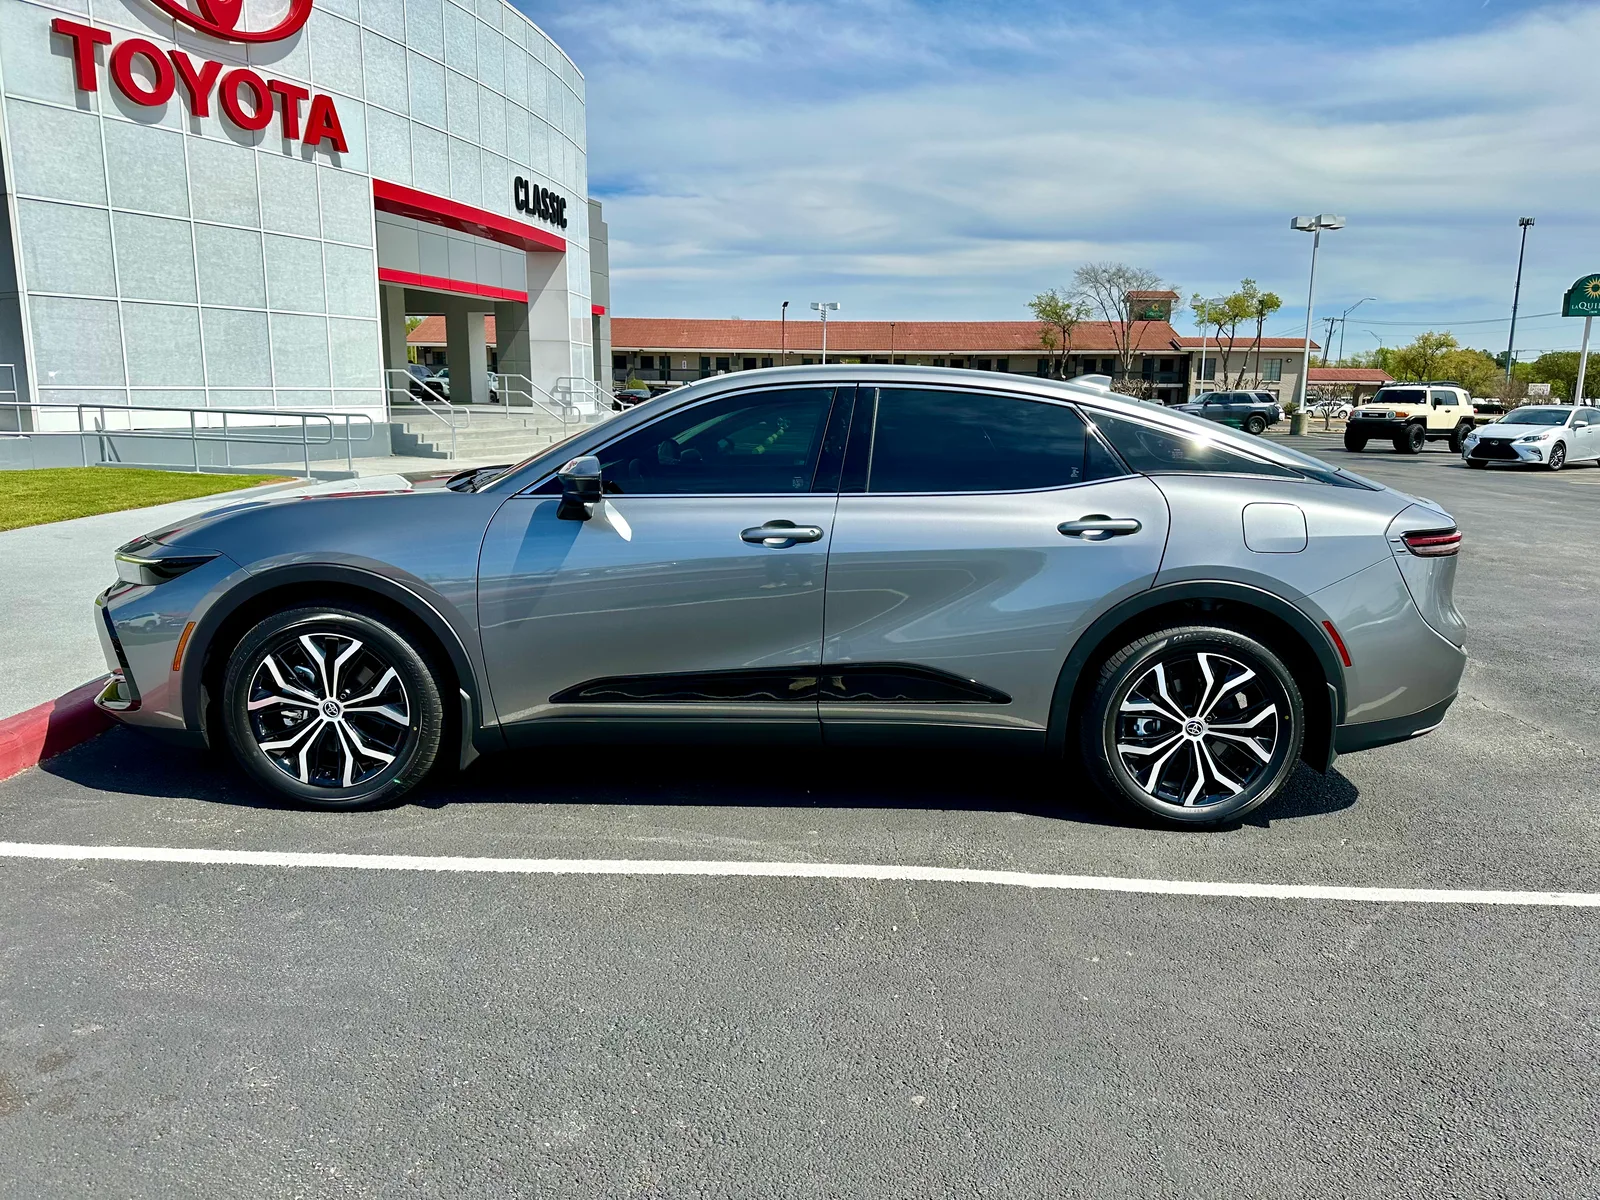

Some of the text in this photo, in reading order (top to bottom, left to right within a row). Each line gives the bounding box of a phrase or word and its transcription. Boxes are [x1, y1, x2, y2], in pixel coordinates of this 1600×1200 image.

[51, 18, 349, 153] TOYOTA
[514, 176, 567, 228] CLASSIC
[1578, 301, 1600, 311] QUI
